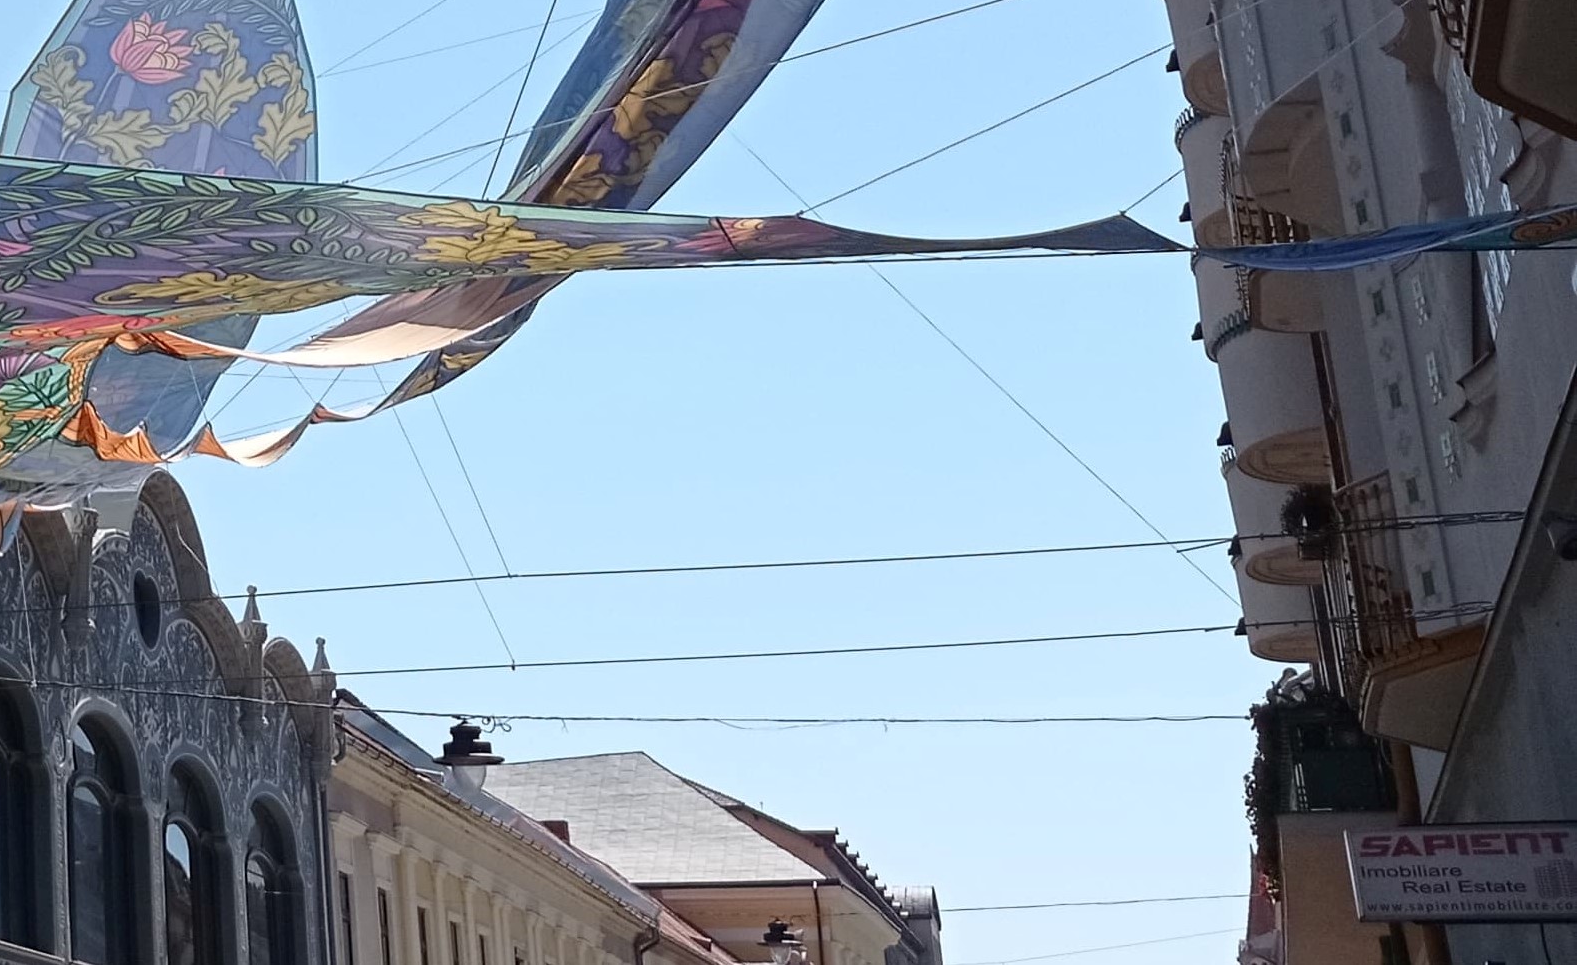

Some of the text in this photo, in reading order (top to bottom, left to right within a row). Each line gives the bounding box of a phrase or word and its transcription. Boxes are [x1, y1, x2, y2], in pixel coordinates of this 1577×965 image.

[1360, 865, 1462, 879] Imobiliare
[1402, 880, 1527, 894] Real Estate
